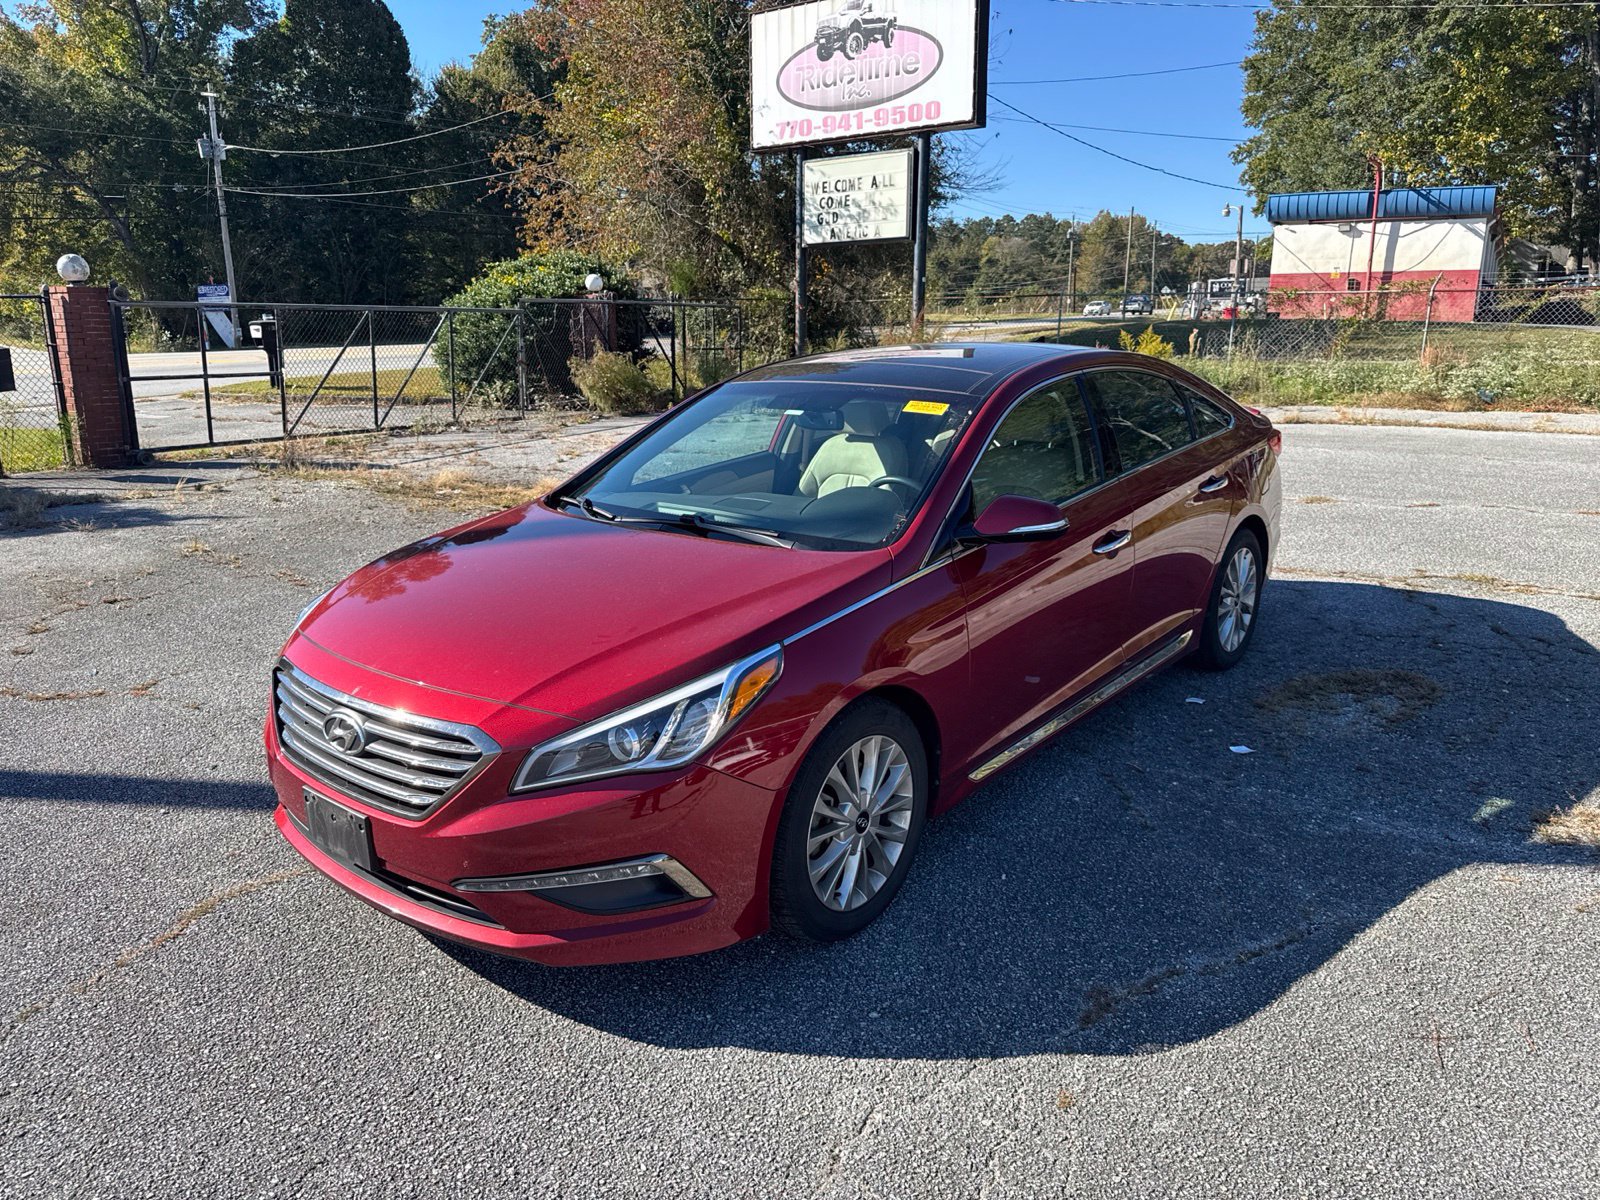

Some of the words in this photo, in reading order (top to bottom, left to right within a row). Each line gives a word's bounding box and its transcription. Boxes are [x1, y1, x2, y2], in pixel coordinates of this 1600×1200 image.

[797, 51, 921, 92] RideTime
[841, 82, 871, 101] Inc.
[776, 100, 941, 140] 770-941-9500
[811, 177, 862, 195] WELCOME
[871, 174, 894, 189] ALL
[820, 195, 850, 209] COME
